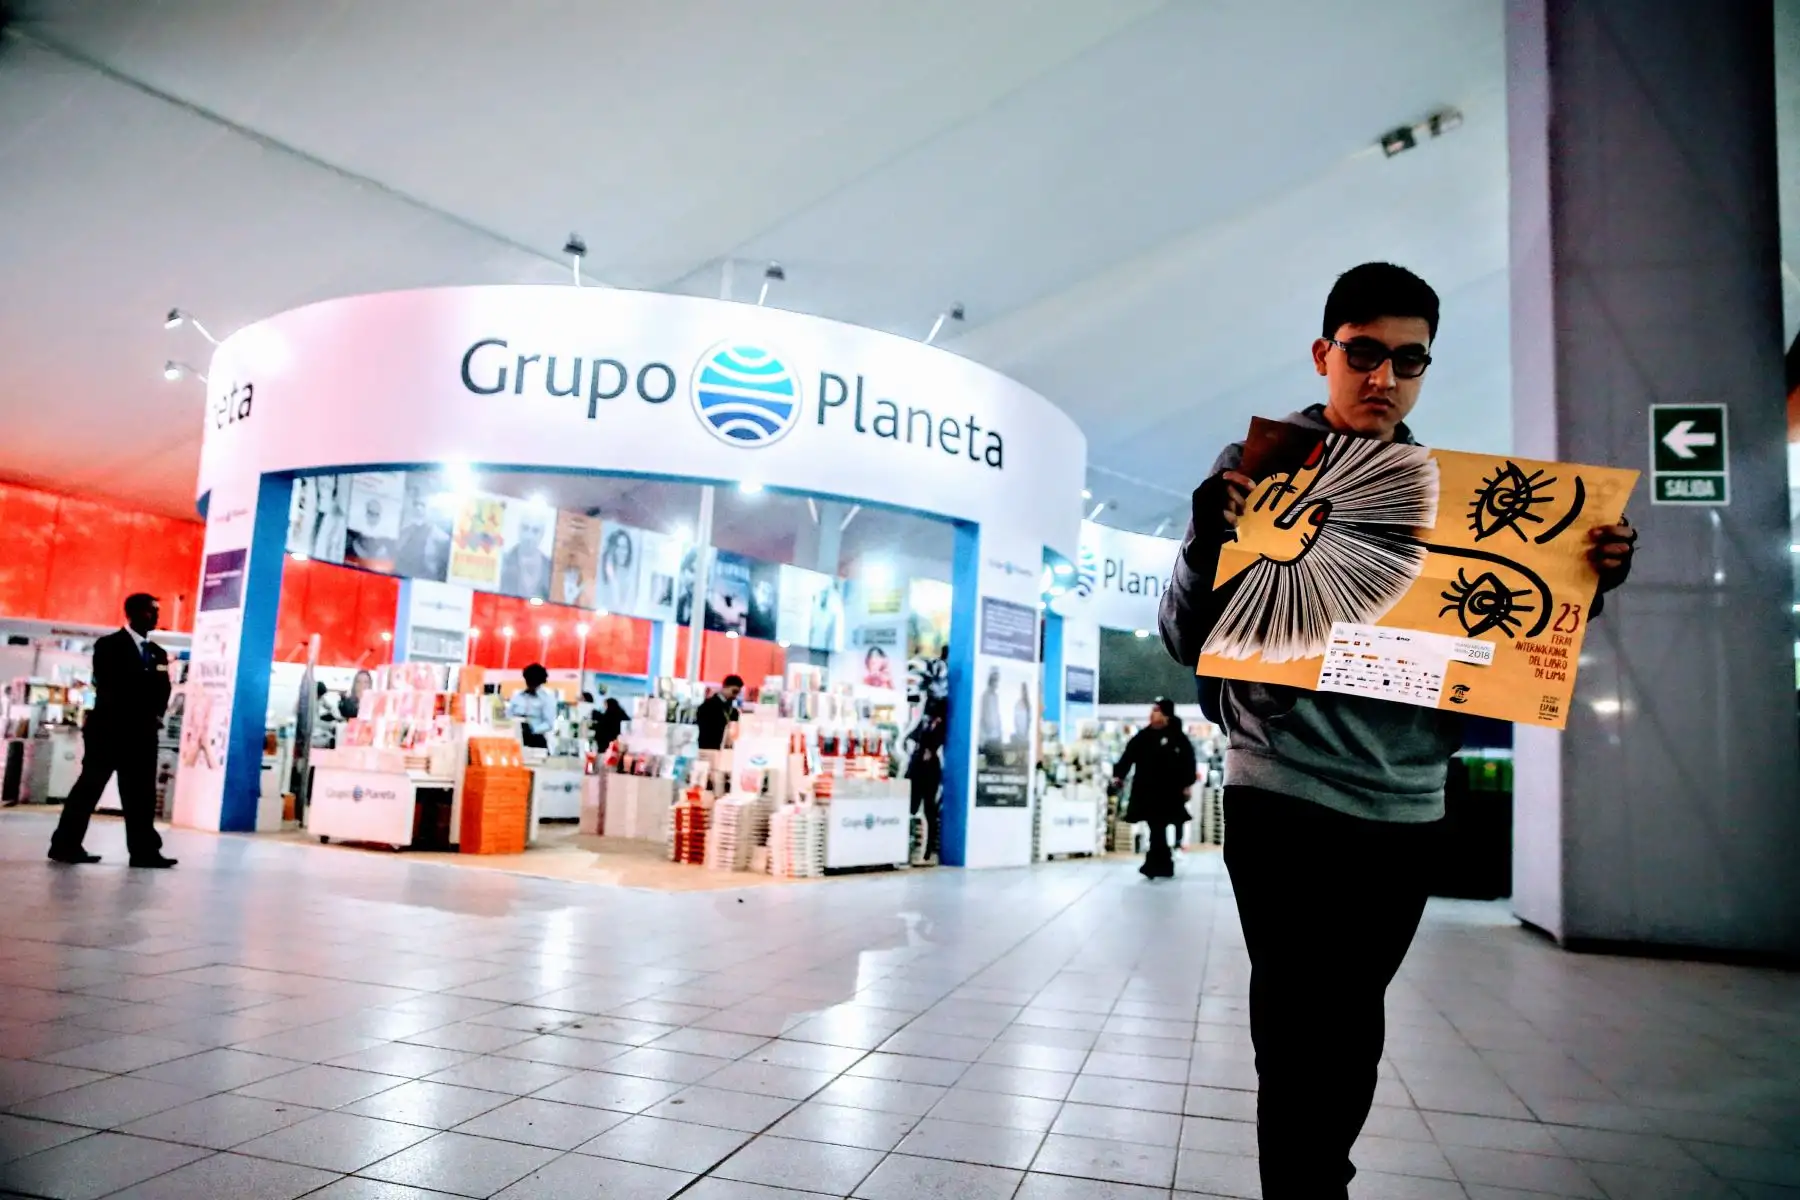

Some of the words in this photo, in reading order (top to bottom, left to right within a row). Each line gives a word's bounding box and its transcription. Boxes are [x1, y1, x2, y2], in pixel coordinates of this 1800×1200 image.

[213, 381, 254, 430] eta
[461, 337, 677, 420] Grupo
[817, 371, 1004, 470] Planeta
[1664, 479, 1716, 497] SALIDA
[1552, 603, 1582, 633] 23
[1551, 634, 1573, 646] FERIA
[1468, 649, 1490, 660] 2018
[1515, 641, 1568, 659] INTERNACIONAL
[1528, 655, 1541, 667] DEL
[1544, 658, 1568, 670] LIBRO
[1534, 668, 1544, 679] DE
[1545, 672, 1566, 682] LIMA
